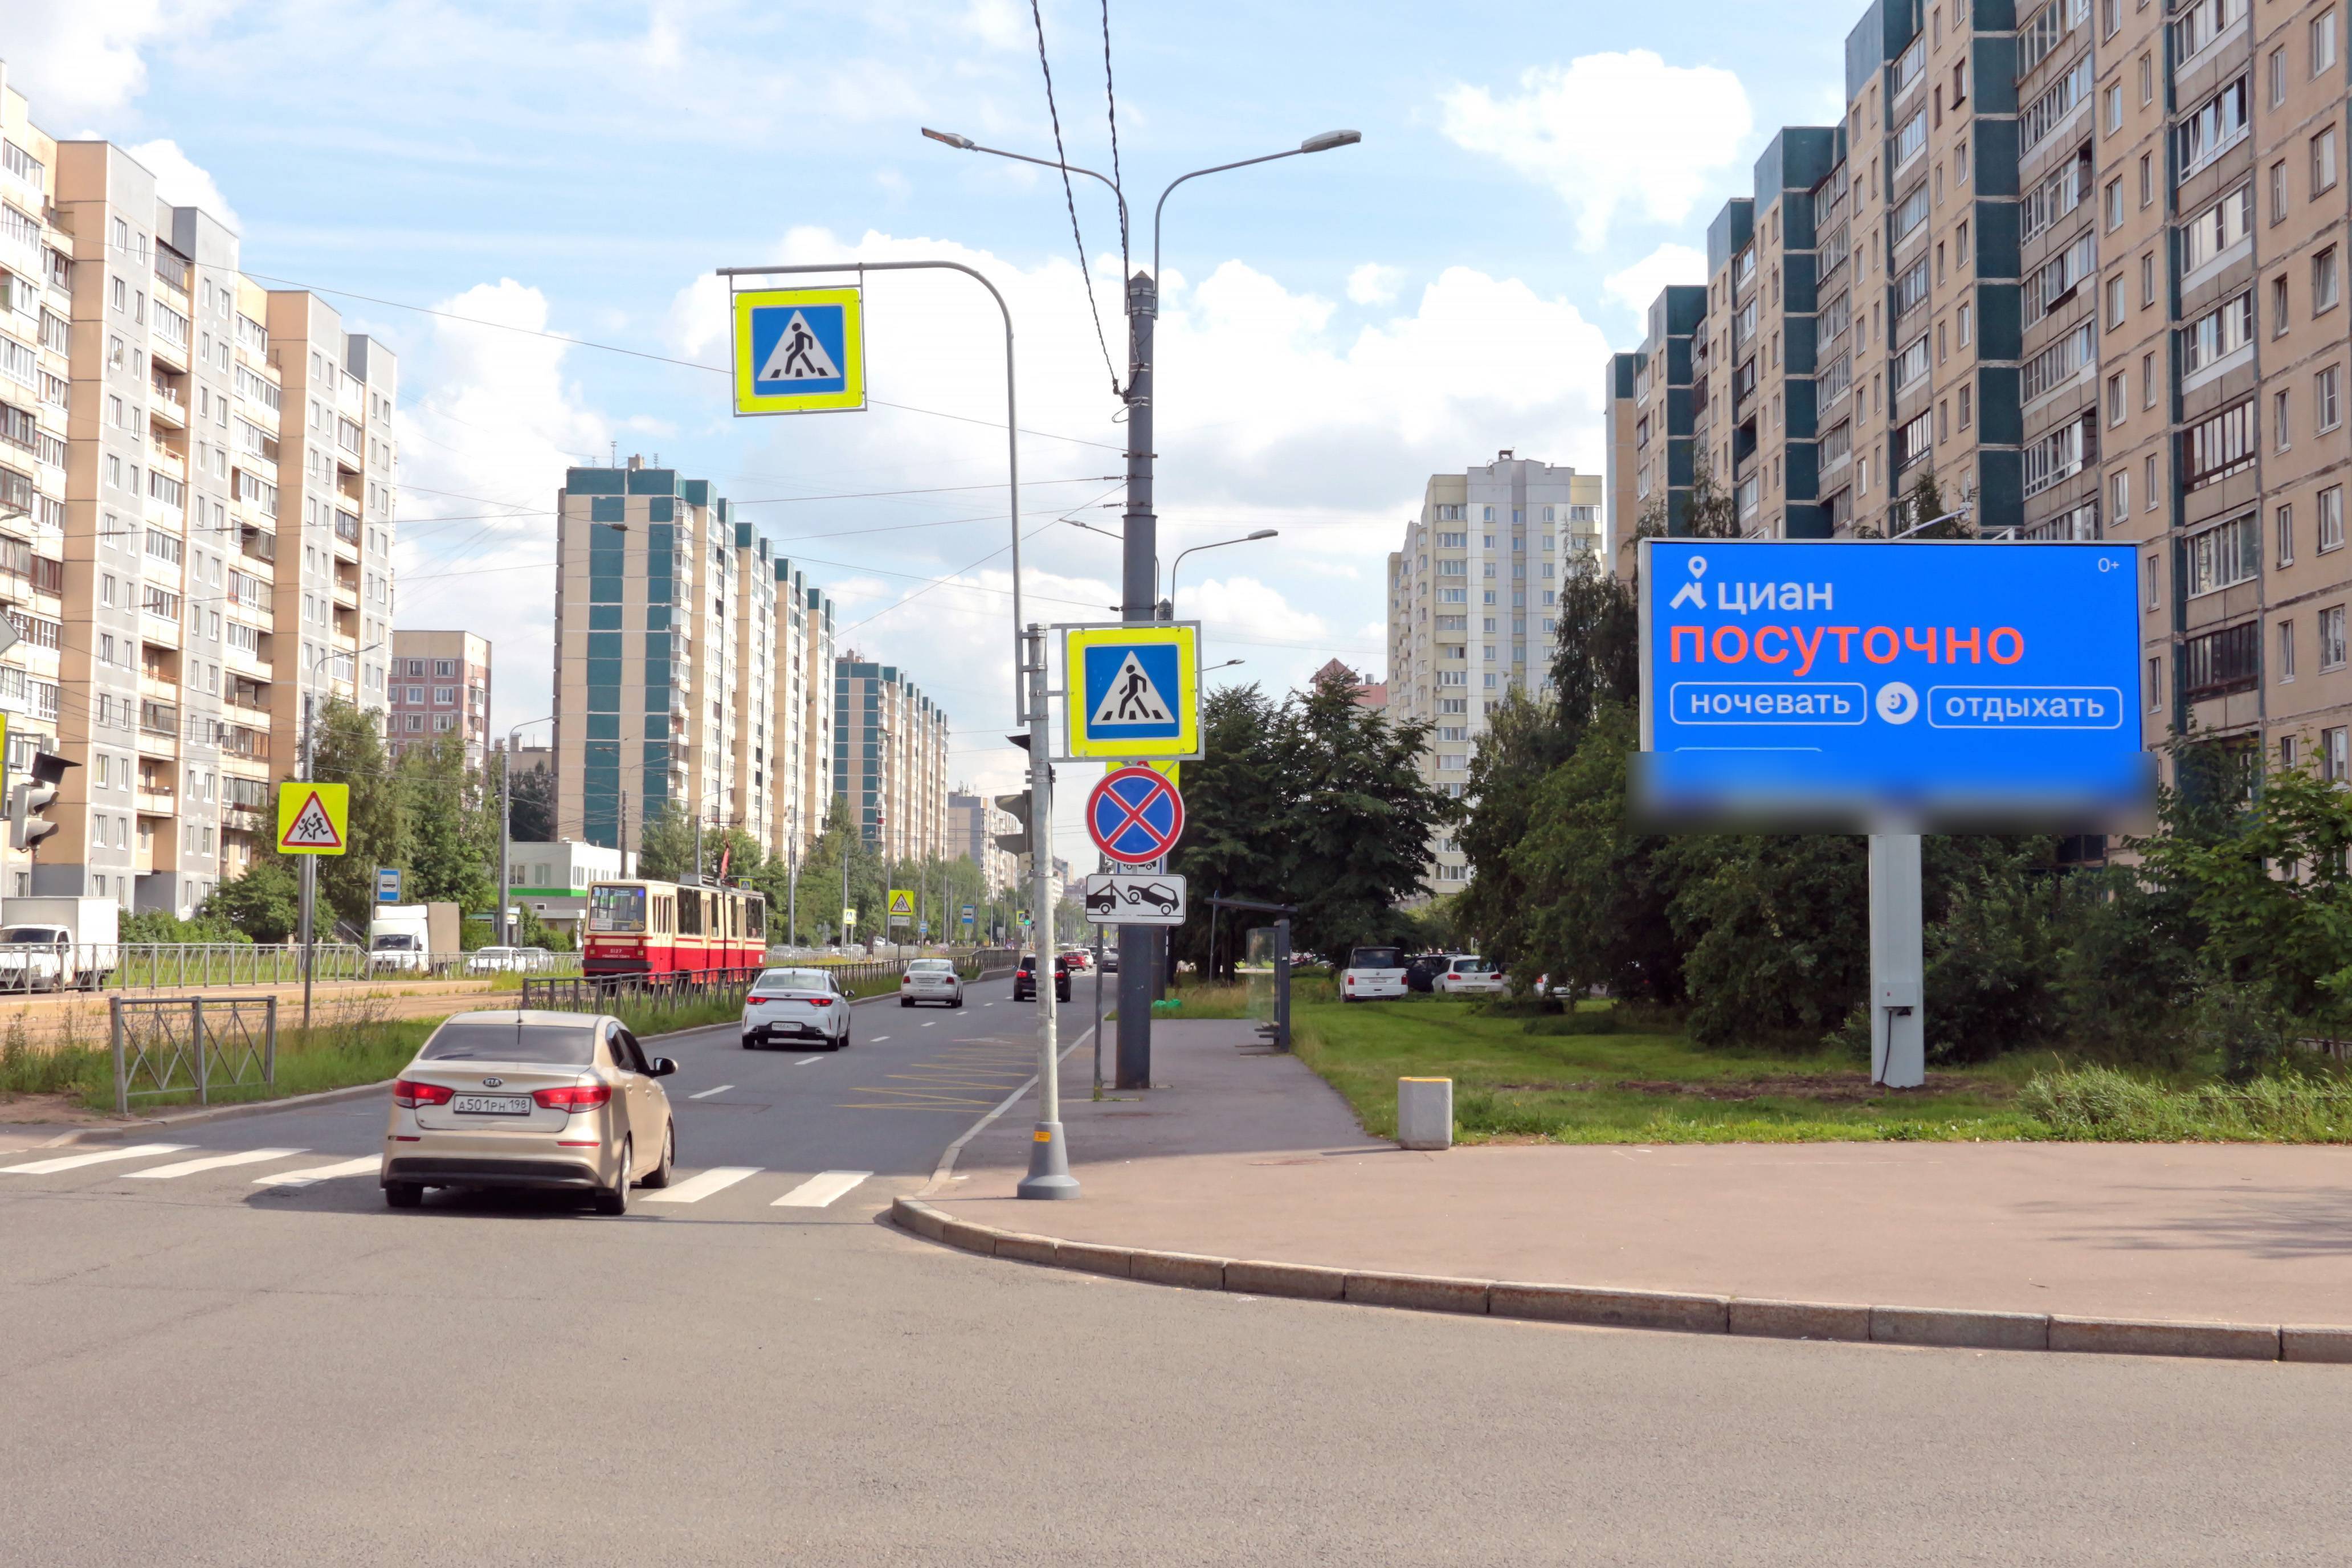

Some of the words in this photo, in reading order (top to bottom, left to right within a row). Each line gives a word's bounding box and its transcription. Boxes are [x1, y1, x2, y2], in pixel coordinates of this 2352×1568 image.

[2098, 557, 2120, 573] 0+
[1717, 581, 1834, 615] циан
[1669, 625, 2024, 677] посуточно
[1690, 693, 1851, 714] ночевать
[1945, 696, 2105, 722] отдыхать
[509, 1099, 526, 1109] 198
